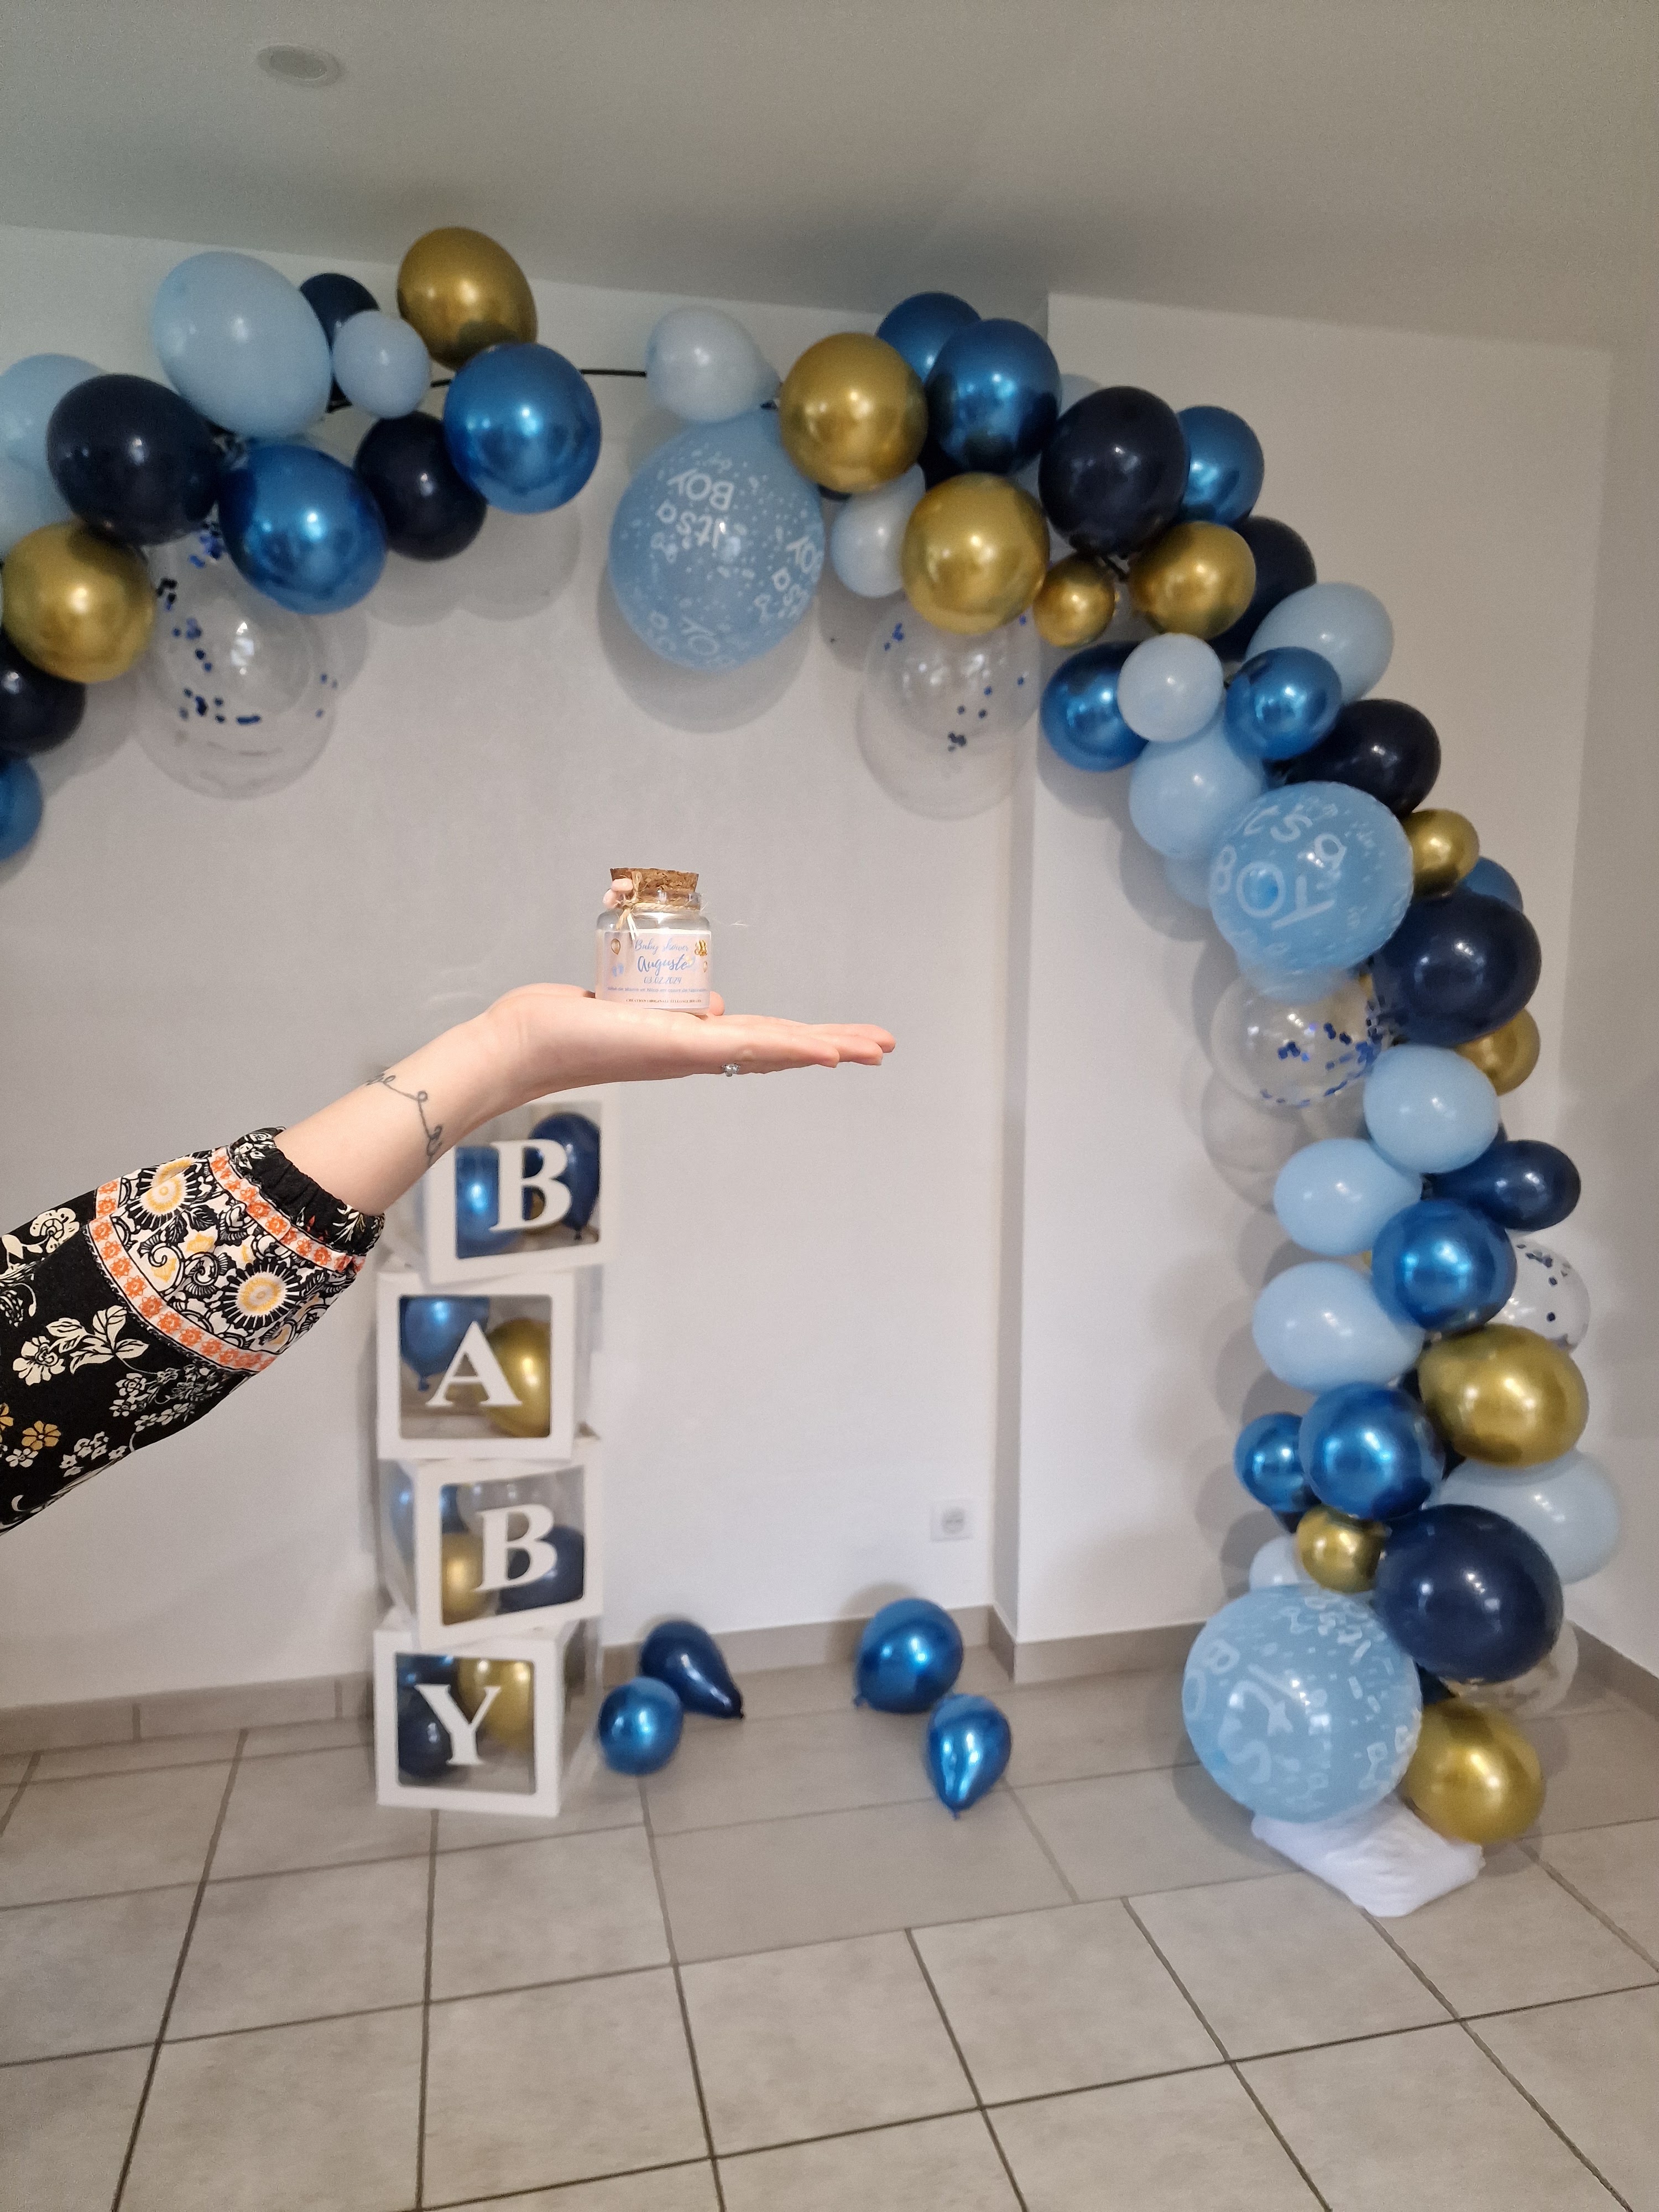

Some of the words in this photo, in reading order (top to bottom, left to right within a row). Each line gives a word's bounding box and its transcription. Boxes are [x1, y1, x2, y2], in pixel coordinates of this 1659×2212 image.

[666, 468, 735, 511] BOY
[634, 938, 659, 955] Baby
[663, 937, 689, 952] shower
[637, 953, 689, 976] Auguste
